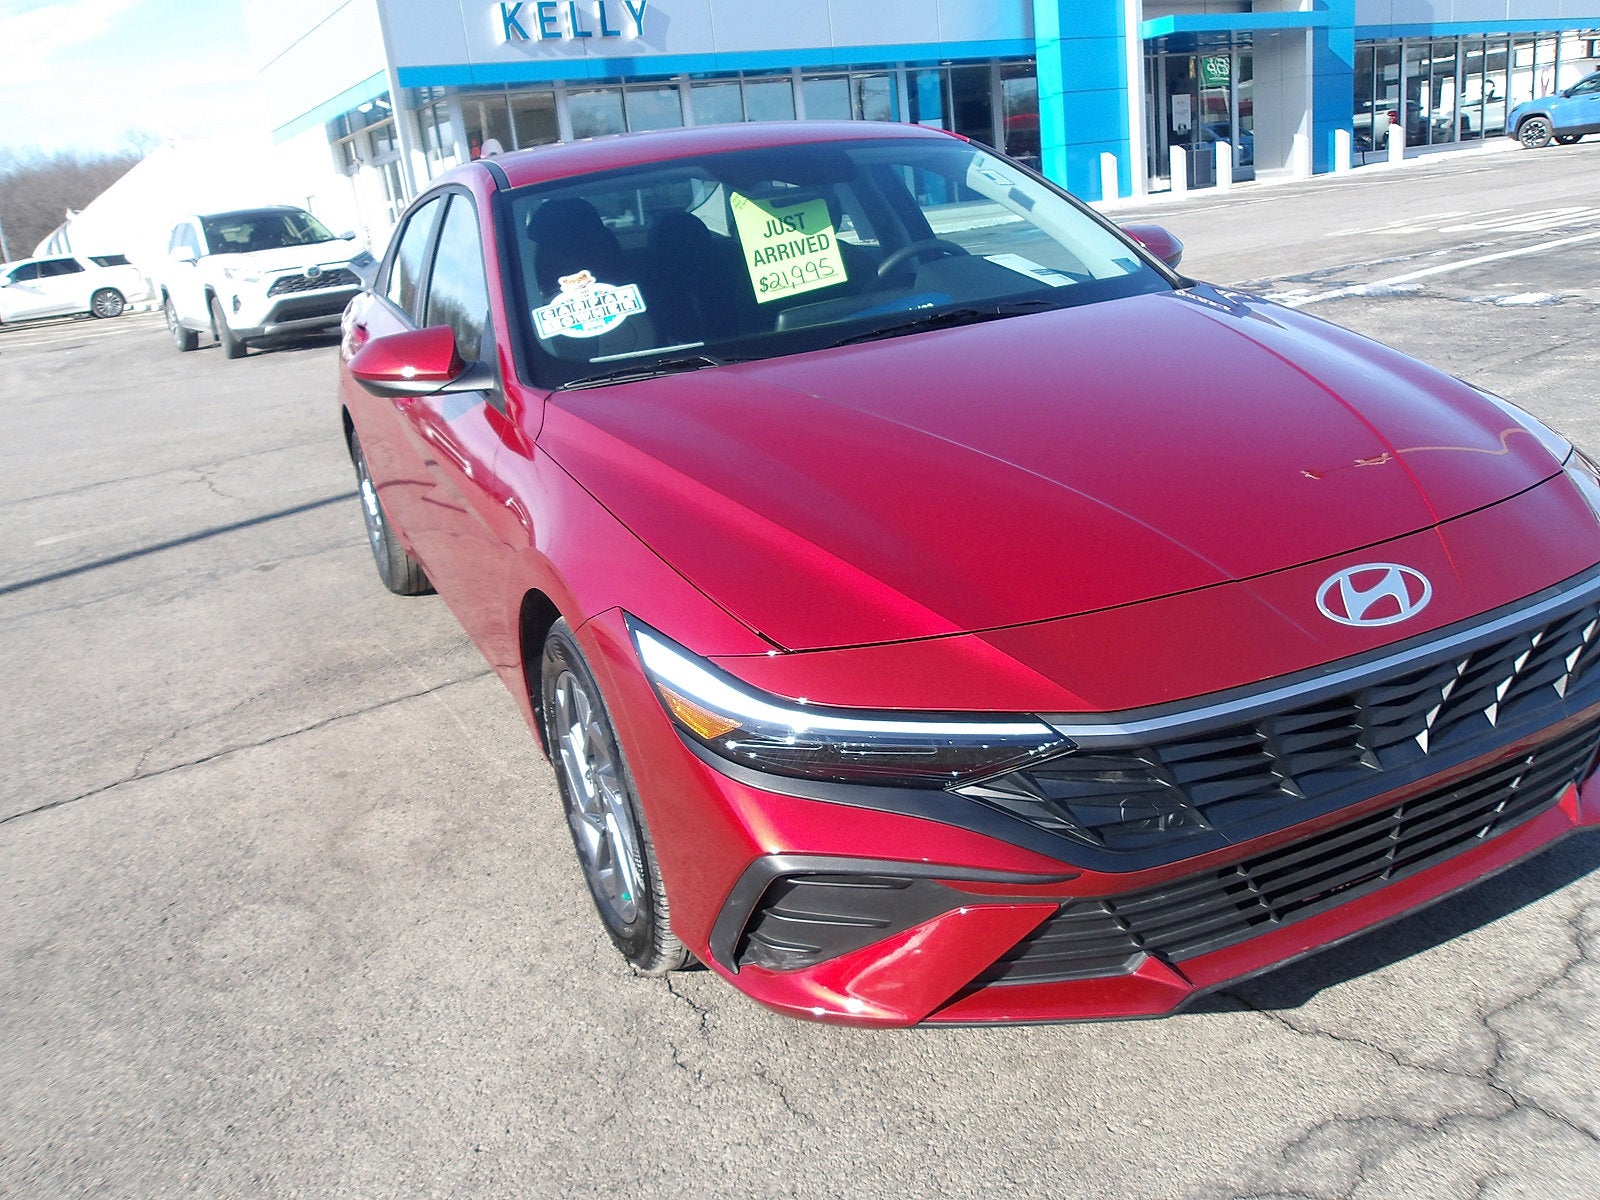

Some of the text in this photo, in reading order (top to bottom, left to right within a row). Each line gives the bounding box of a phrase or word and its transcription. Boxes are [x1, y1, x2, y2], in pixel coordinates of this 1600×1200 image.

[499, 0, 648, 41] KELLY
[763, 211, 806, 239] JUST
[753, 233, 831, 267] ARRIVED
[759, 257, 835, 294] $21,995
